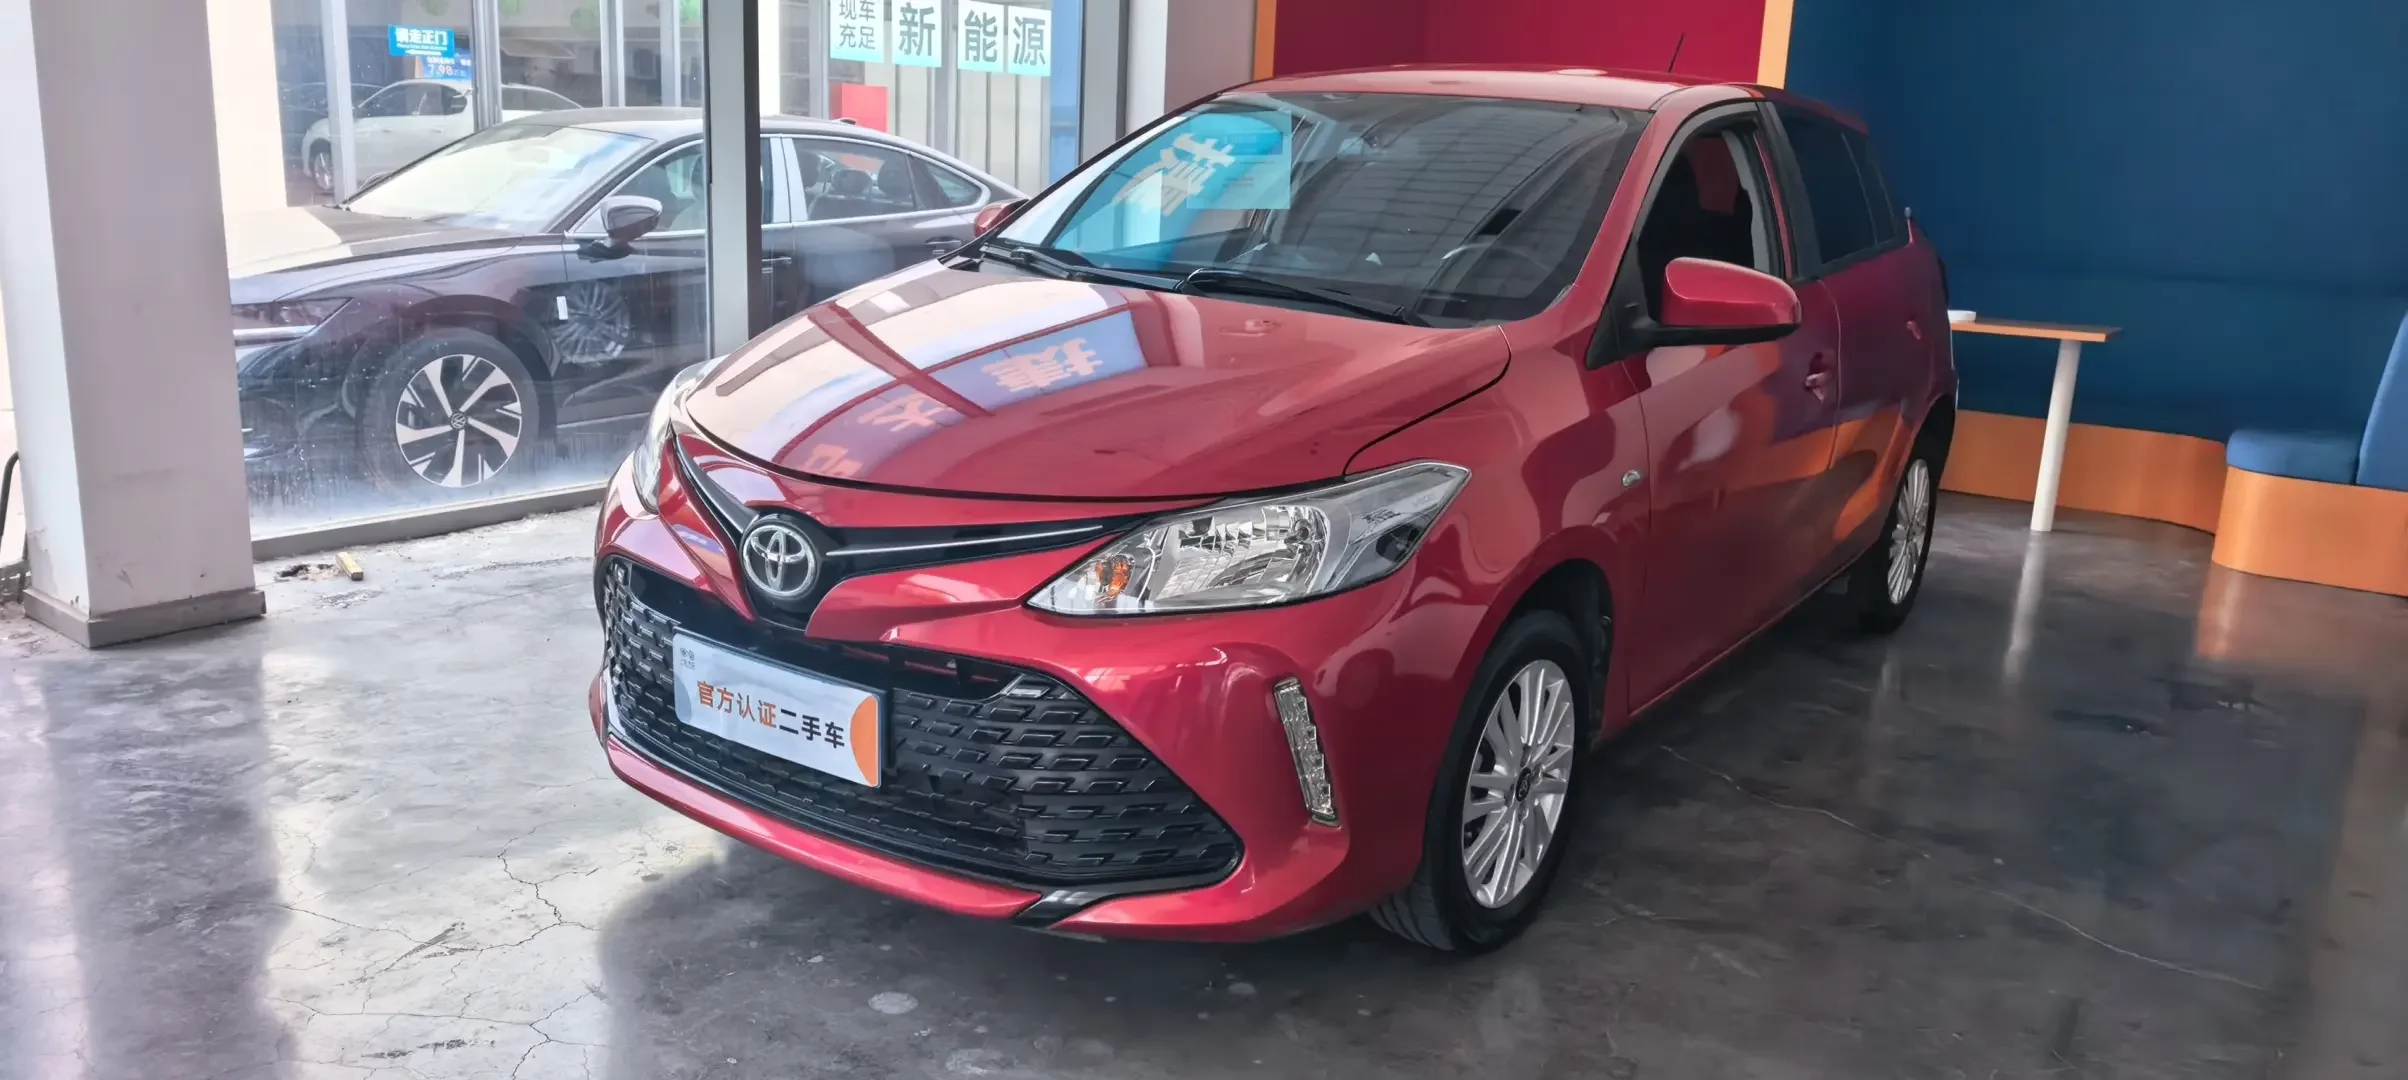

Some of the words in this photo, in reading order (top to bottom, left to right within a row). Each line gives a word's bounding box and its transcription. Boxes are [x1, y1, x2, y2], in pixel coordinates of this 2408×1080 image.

[839, 0, 876, 21] 现车
[839, 23, 876, 50] 充足
[697, 680, 845, 749] 官方认证二手车
